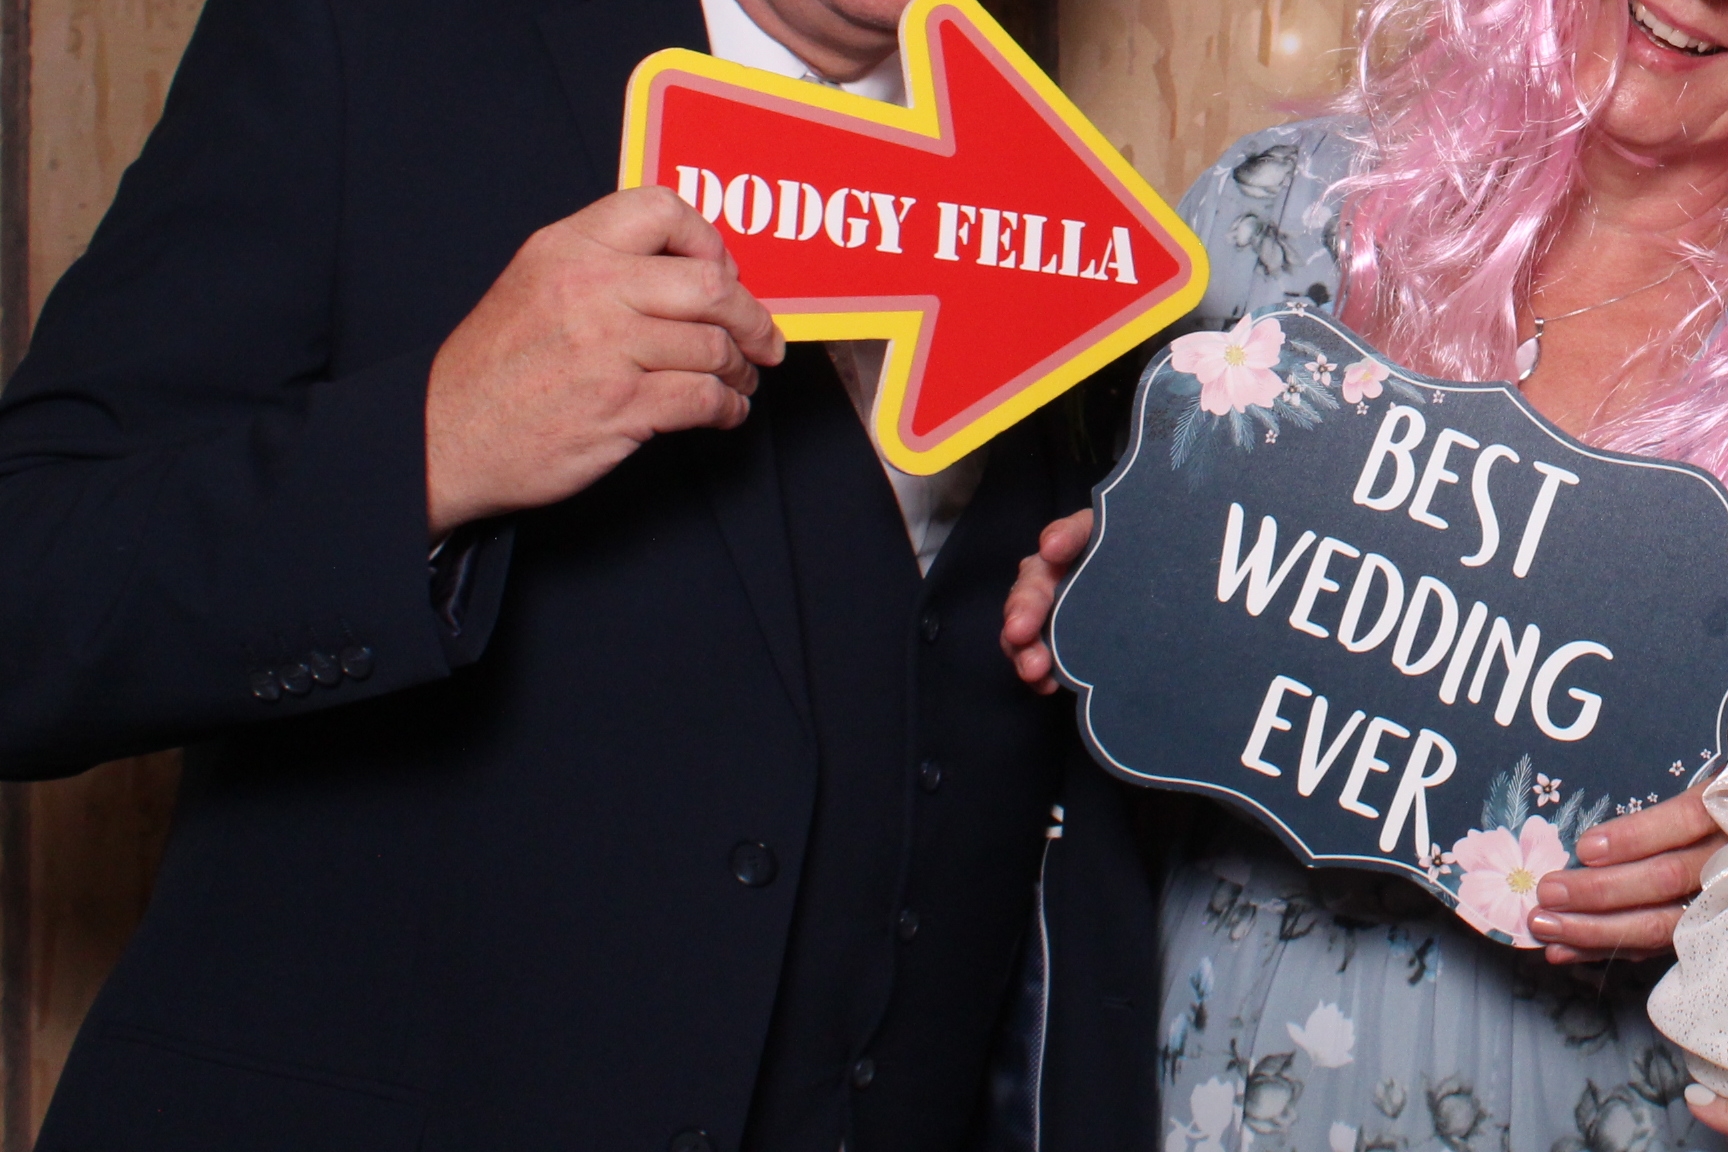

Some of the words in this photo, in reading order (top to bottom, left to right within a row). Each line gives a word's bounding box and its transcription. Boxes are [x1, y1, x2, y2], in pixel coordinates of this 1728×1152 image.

[675, 165, 917, 254] DODGY
[934, 201, 1139, 285] FELLA
[1352, 401, 1581, 578] BEST
[1217, 502, 1614, 741] WEDDING
[1241, 675, 1458, 855] EVER
